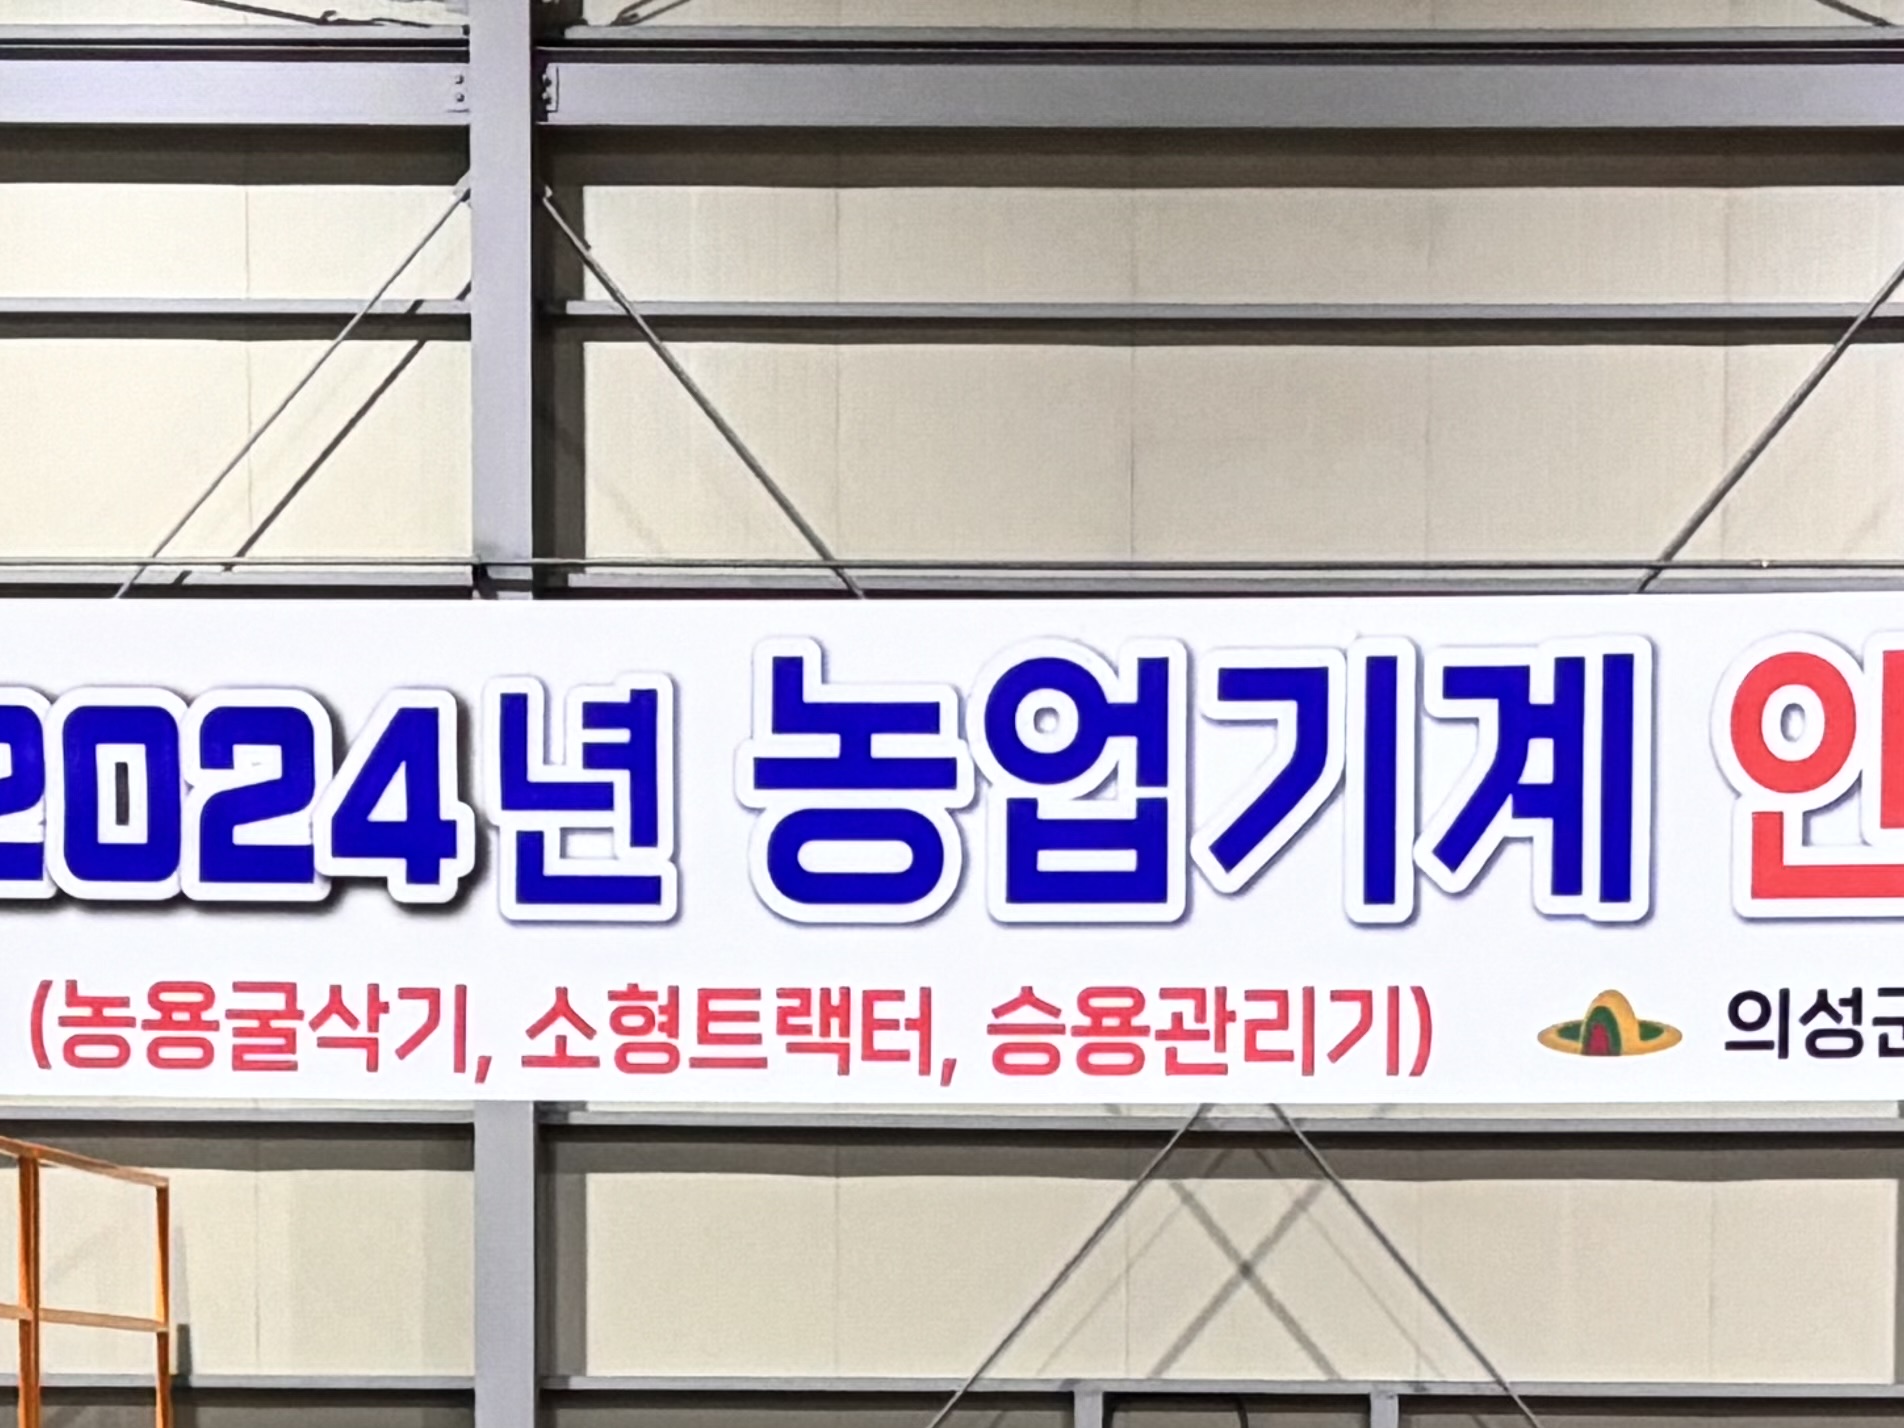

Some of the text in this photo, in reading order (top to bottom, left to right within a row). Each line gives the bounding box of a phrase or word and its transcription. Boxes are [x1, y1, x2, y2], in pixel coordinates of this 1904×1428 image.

[751, 653, 1637, 906] 농업기계
[30, 978, 1434, 1088] (농용굴삭기, 소형트랙터, 승용관리기)
